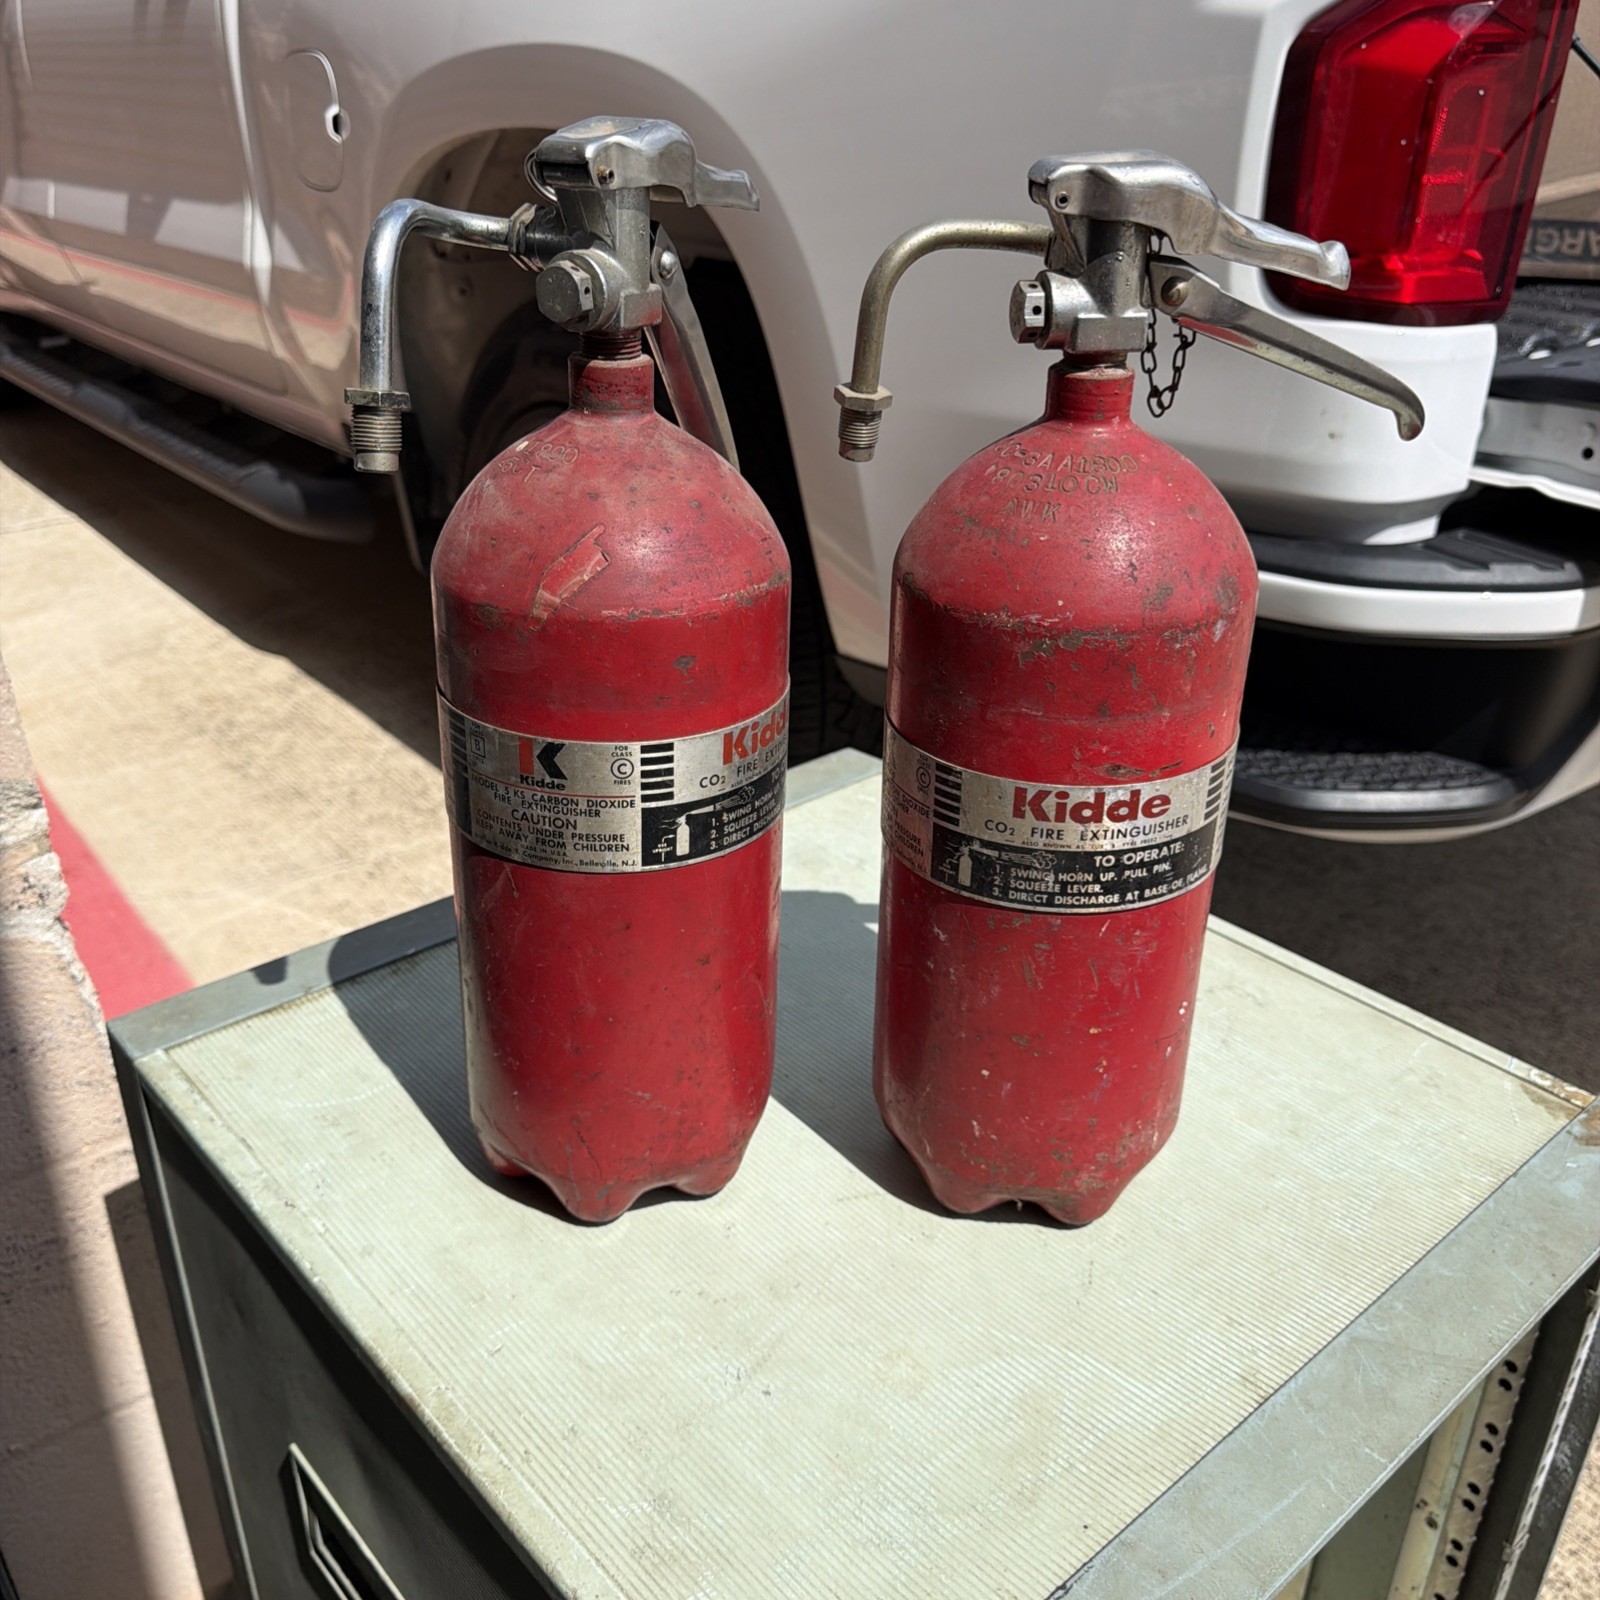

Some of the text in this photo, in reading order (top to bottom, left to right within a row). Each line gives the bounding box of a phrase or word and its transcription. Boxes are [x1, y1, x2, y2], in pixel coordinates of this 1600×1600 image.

[737, 759, 758, 778] FIRE
[471, 774, 499, 793] MODEL
[513, 789, 526, 800] KS
[532, 793, 579, 808] CARBON
[587, 799, 636, 809] DIOXIDE
[520, 775, 567, 792] Kidde
[494, 792, 601, 819] FIRE EXTINGUISHER
[722, 804, 752, 823] SWING
[1012, 786, 1172, 825] Kidde
[477, 808, 626, 843] CONTENTS UNDER PRESSURE
[511, 809, 578, 831] CAUTION
[723, 812, 758, 835] SQUEEZE
[1031, 827, 1065, 840] FIRE
[1080, 814, 1188, 841] EXTINGUISHER
[498, 828, 529, 843] AWAY
[535, 837, 567, 850] FROM
[573, 842, 630, 852] CHILDREN
[723, 828, 751, 846] DIRECT
[522, 850, 561, 865] Company,
[1094, 841, 1185, 868] TO OPERATE:
[1010, 868, 1055, 882] SWING
[1058, 872, 1094, 882] HORN
[1124, 867, 1149, 879] PULL
[1008, 890, 1048, 904] DIRECT
[1054, 893, 1120, 905] DISCHARGE
[1125, 890, 1140, 901] AT
[1144, 883, 1168, 898] BASE
[1009, 879, 1061, 893] SQUEEZE
[1067, 884, 1104, 894] LEVER.
